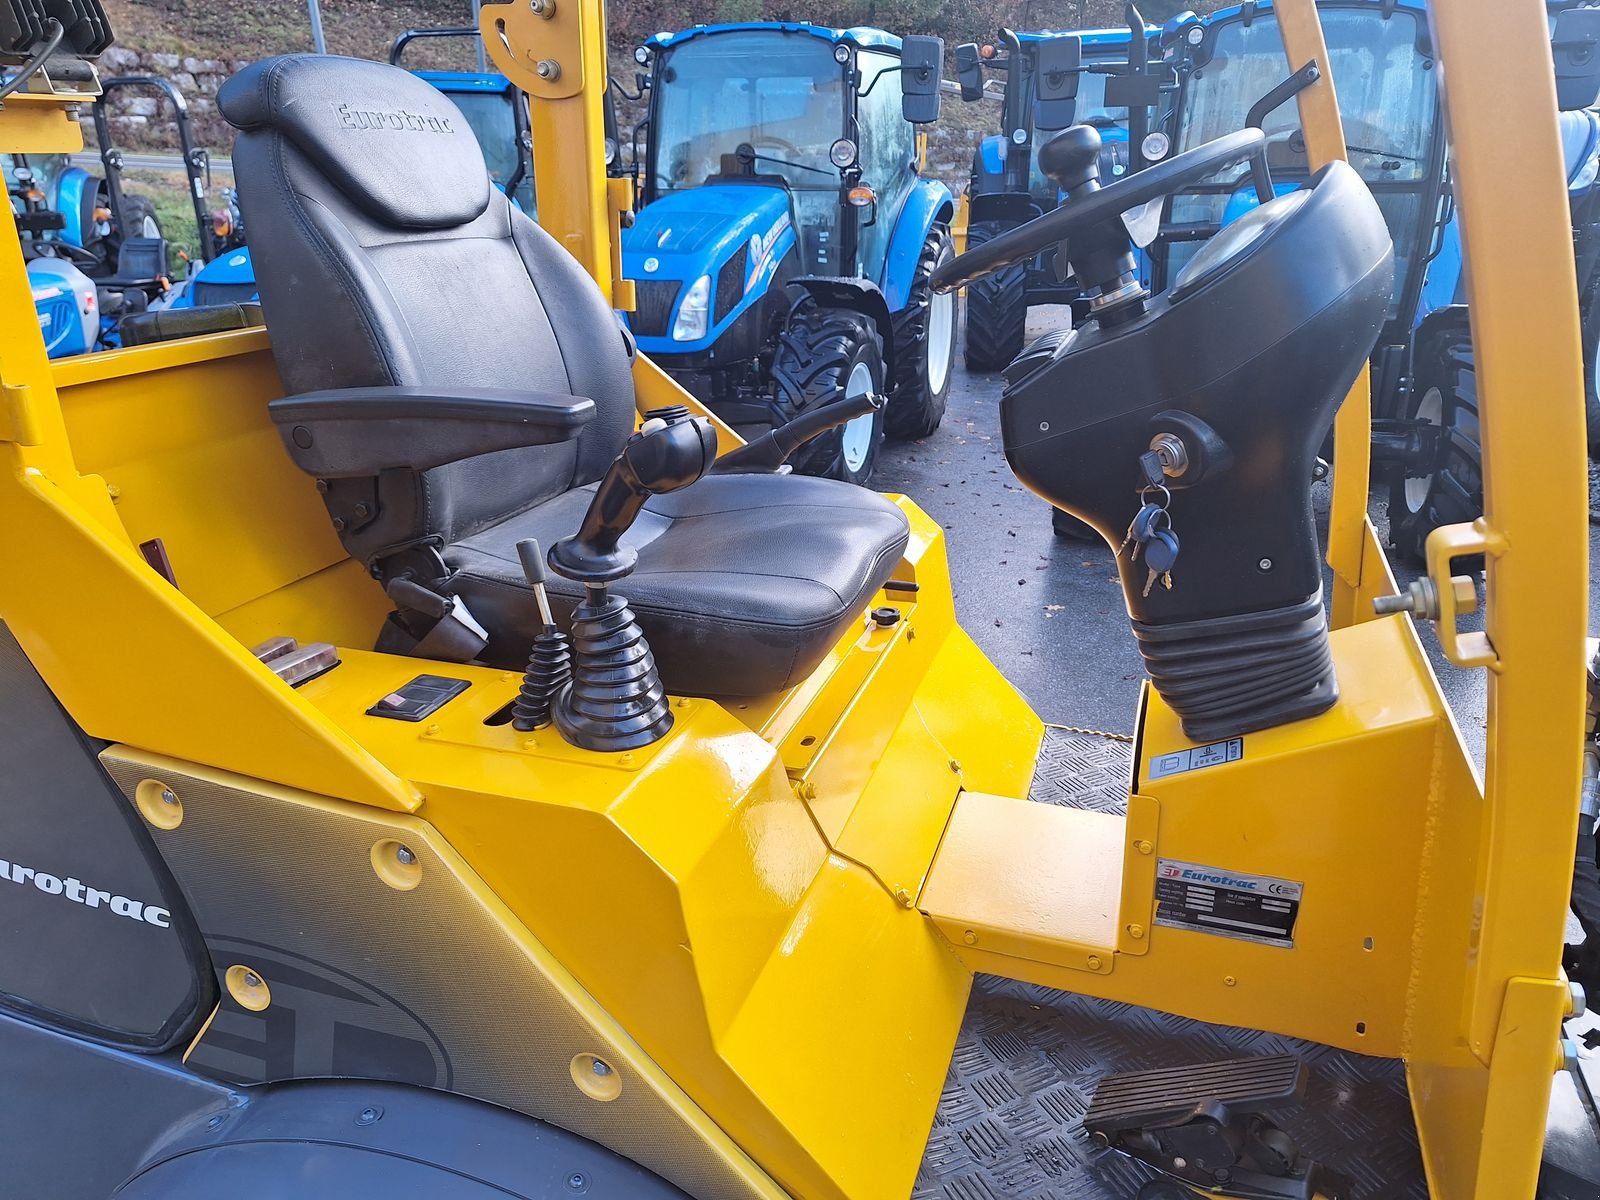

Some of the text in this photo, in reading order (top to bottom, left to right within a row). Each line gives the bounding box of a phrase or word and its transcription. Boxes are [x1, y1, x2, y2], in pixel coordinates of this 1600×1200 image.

[331, 103, 455, 134] Eurotrac
[1182, 869, 1257, 890] Eurotrac
[1269, 883, 1283, 895] CE
